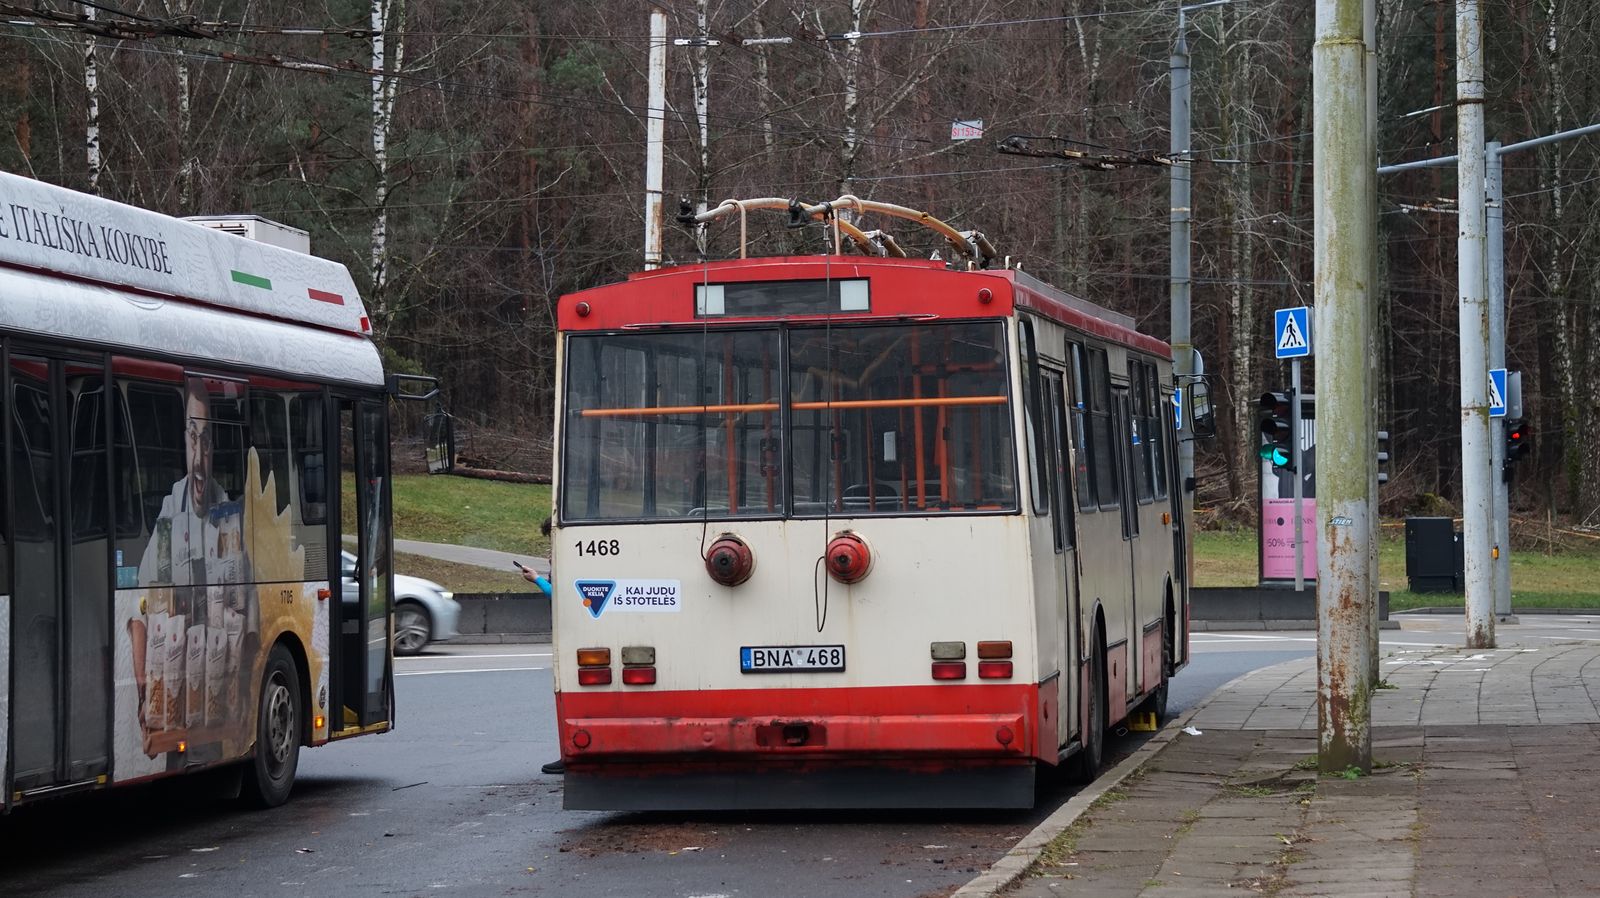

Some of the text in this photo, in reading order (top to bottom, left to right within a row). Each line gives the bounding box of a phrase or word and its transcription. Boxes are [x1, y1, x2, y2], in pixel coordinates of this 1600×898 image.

[9, 203, 102, 259] ITALIŠKA
[100, 226, 173, 275] KOKYBĖ
[575, 539, 620, 557] 1468
[613, 594, 676, 605] IŠ STOTELĖS
[626, 586, 676, 595] KAI JUDU
[753, 650, 793, 667] BNA
[807, 649, 840, 666] 468
